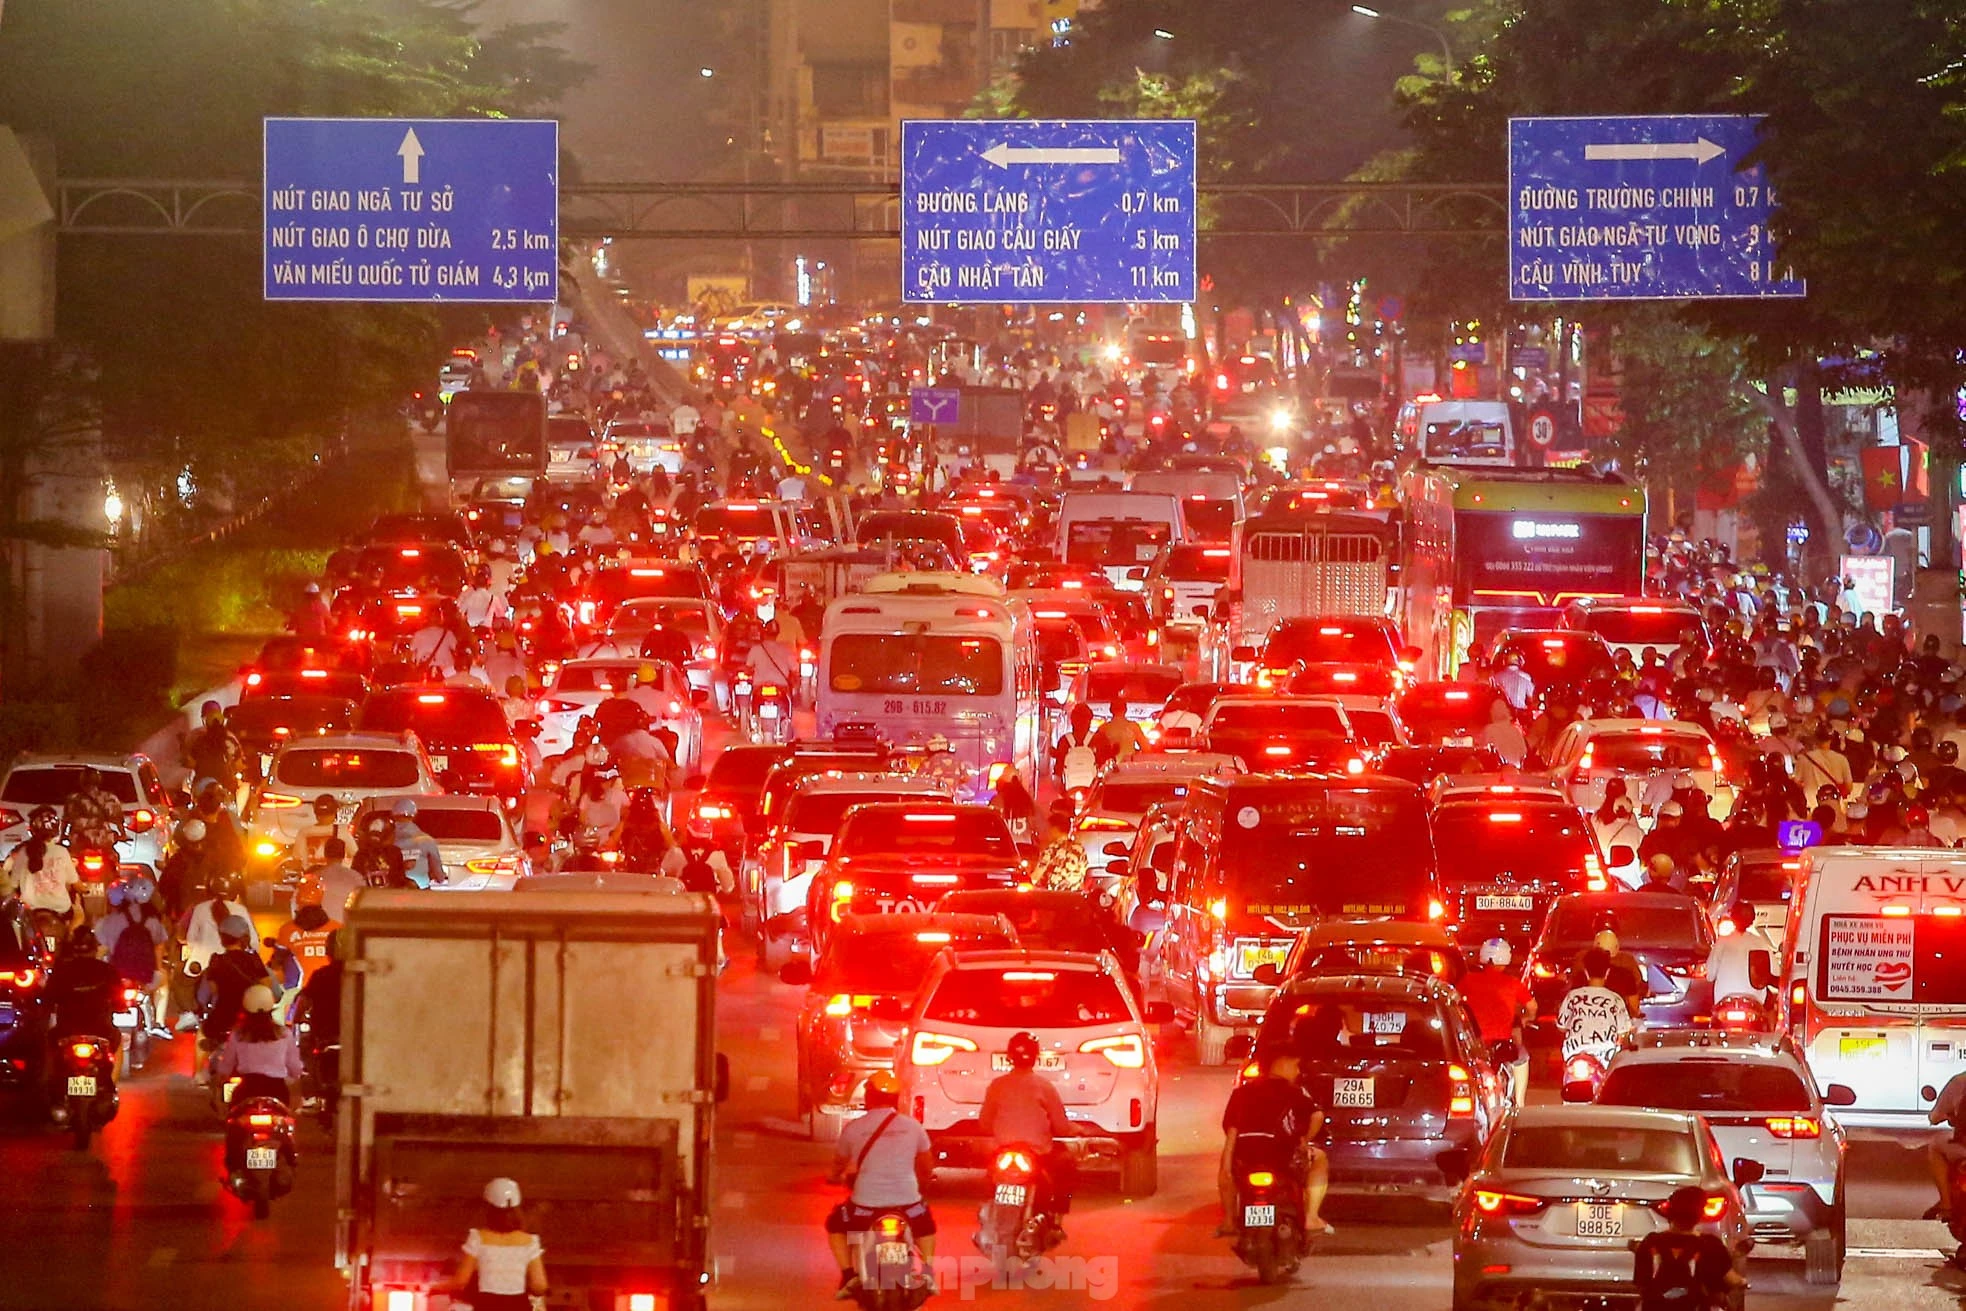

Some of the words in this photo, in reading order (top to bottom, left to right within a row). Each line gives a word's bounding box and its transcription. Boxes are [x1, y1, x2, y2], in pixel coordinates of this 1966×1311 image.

[272, 184, 306, 211] NÚT
[311, 190, 350, 211] GIAO
[358, 186, 392, 212] NGÃ
[401, 190, 423, 212] TƯ
[431, 184, 454, 212] SỞ
[917, 186, 976, 213] ĐƯỜNG
[984, 186, 1028, 213] LÁNG
[1121, 193, 1146, 213] 0,7
[1153, 192, 1179, 213] km
[1520, 183, 1578, 210] ĐƯỜNG
[1586, 182, 1655, 209] TRƯỜNG
[1662, 187, 1713, 208] CHINH
[272, 221, 306, 248] NÚT
[311, 227, 350, 248] GIAO
[357, 224, 368, 248] Ô
[376, 227, 409, 252] CHỢ
[418, 222, 451, 249] DỪA
[492, 230, 516, 250] 2,5
[524, 230, 549, 249] km
[918, 223, 950, 250] NÚT
[957, 229, 995, 250] GIAO
[1003, 222, 1035, 250] CẦU
[1043, 222, 1081, 250] GIẤY
[1136, 230, 1146, 250] 5
[1153, 230, 1179, 250] km
[1520, 220, 1554, 248] NÚT
[1560, 225, 1599, 247] GIAO
[1604, 221, 1638, 247] NGÃ
[1645, 224, 1668, 247] TƯ
[273, 260, 306, 285] VĂN
[312, 257, 352, 285] MIẾU
[358, 257, 402, 286] QUỐC
[409, 258, 431, 285] TỬ
[438, 260, 479, 286] GIÁM
[524, 267, 549, 287] km
[918, 260, 950, 287] CẦU
[958, 259, 1001, 290] NHẬT
[1130, 267, 1146, 286] 11
[1154, 267, 1179, 287] km
[1521, 257, 1553, 285] CẦU
[1562, 260, 1601, 285] VĨNH
[1610, 263, 1641, 284] TUY
[1750, 261, 1759, 281] 8
[1852, 876, 1929, 892] ANH
[1831, 932, 1855, 945] PHỤC
[1334, 1093, 1373, 1105] 768.65
[1343, 1080, 1365, 1092] 29A
[1589, 1206, 1612, 1220] 30E
[1579, 1220, 1621, 1235] 988.52
